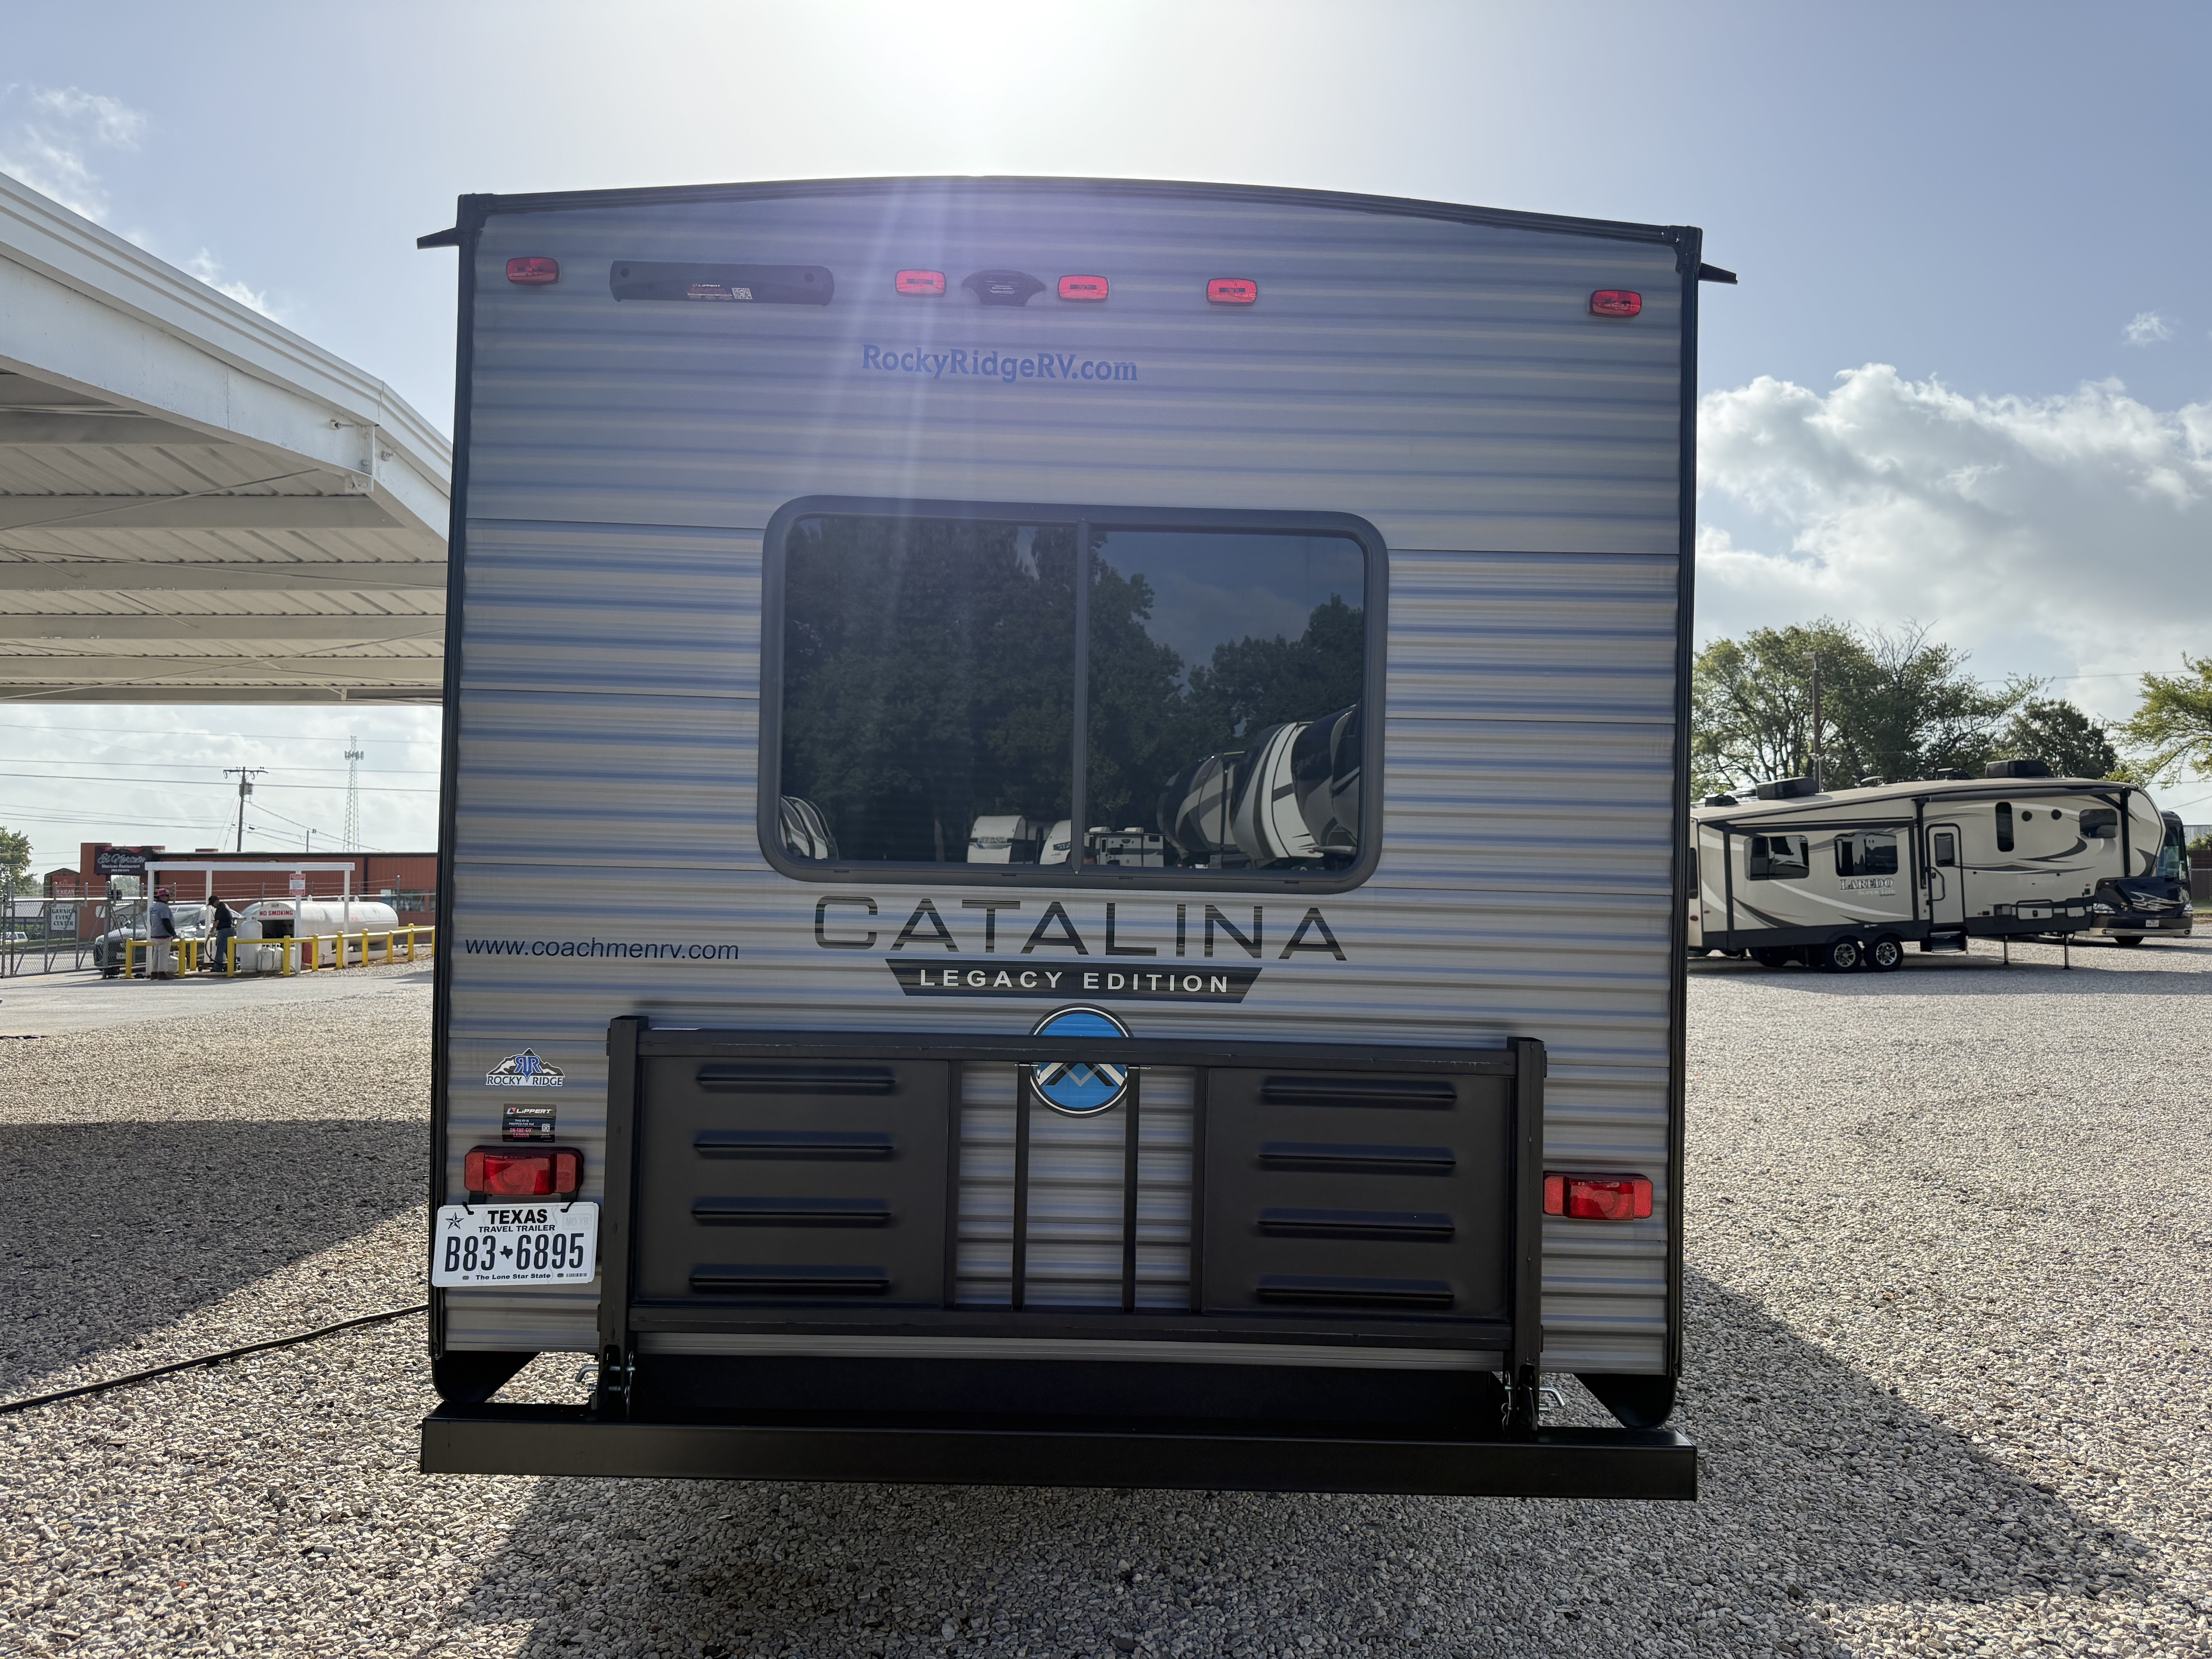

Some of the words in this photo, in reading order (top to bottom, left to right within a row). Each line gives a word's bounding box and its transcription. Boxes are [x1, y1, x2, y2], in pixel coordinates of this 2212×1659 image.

[862, 344, 1139, 383] RockyRidgeRV.com
[1840, 878, 1894, 890] LAREDO
[814, 895, 1347, 961] CATALINA
[465, 937, 738, 960] www.coachmenrv.com
[921, 969, 1063, 988] LEGACY
[1084, 972, 1227, 993] EDITION
[487, 1076, 522, 1085] ROCKY
[533, 1077, 562, 1085] RIDGE
[488, 1209, 548, 1224] TEXAS
[565, 1218, 577, 1226] MO
[578, 1217, 589, 1225] YR
[445, 1235, 496, 1272] B83
[516, 1233, 584, 1270] 6895
